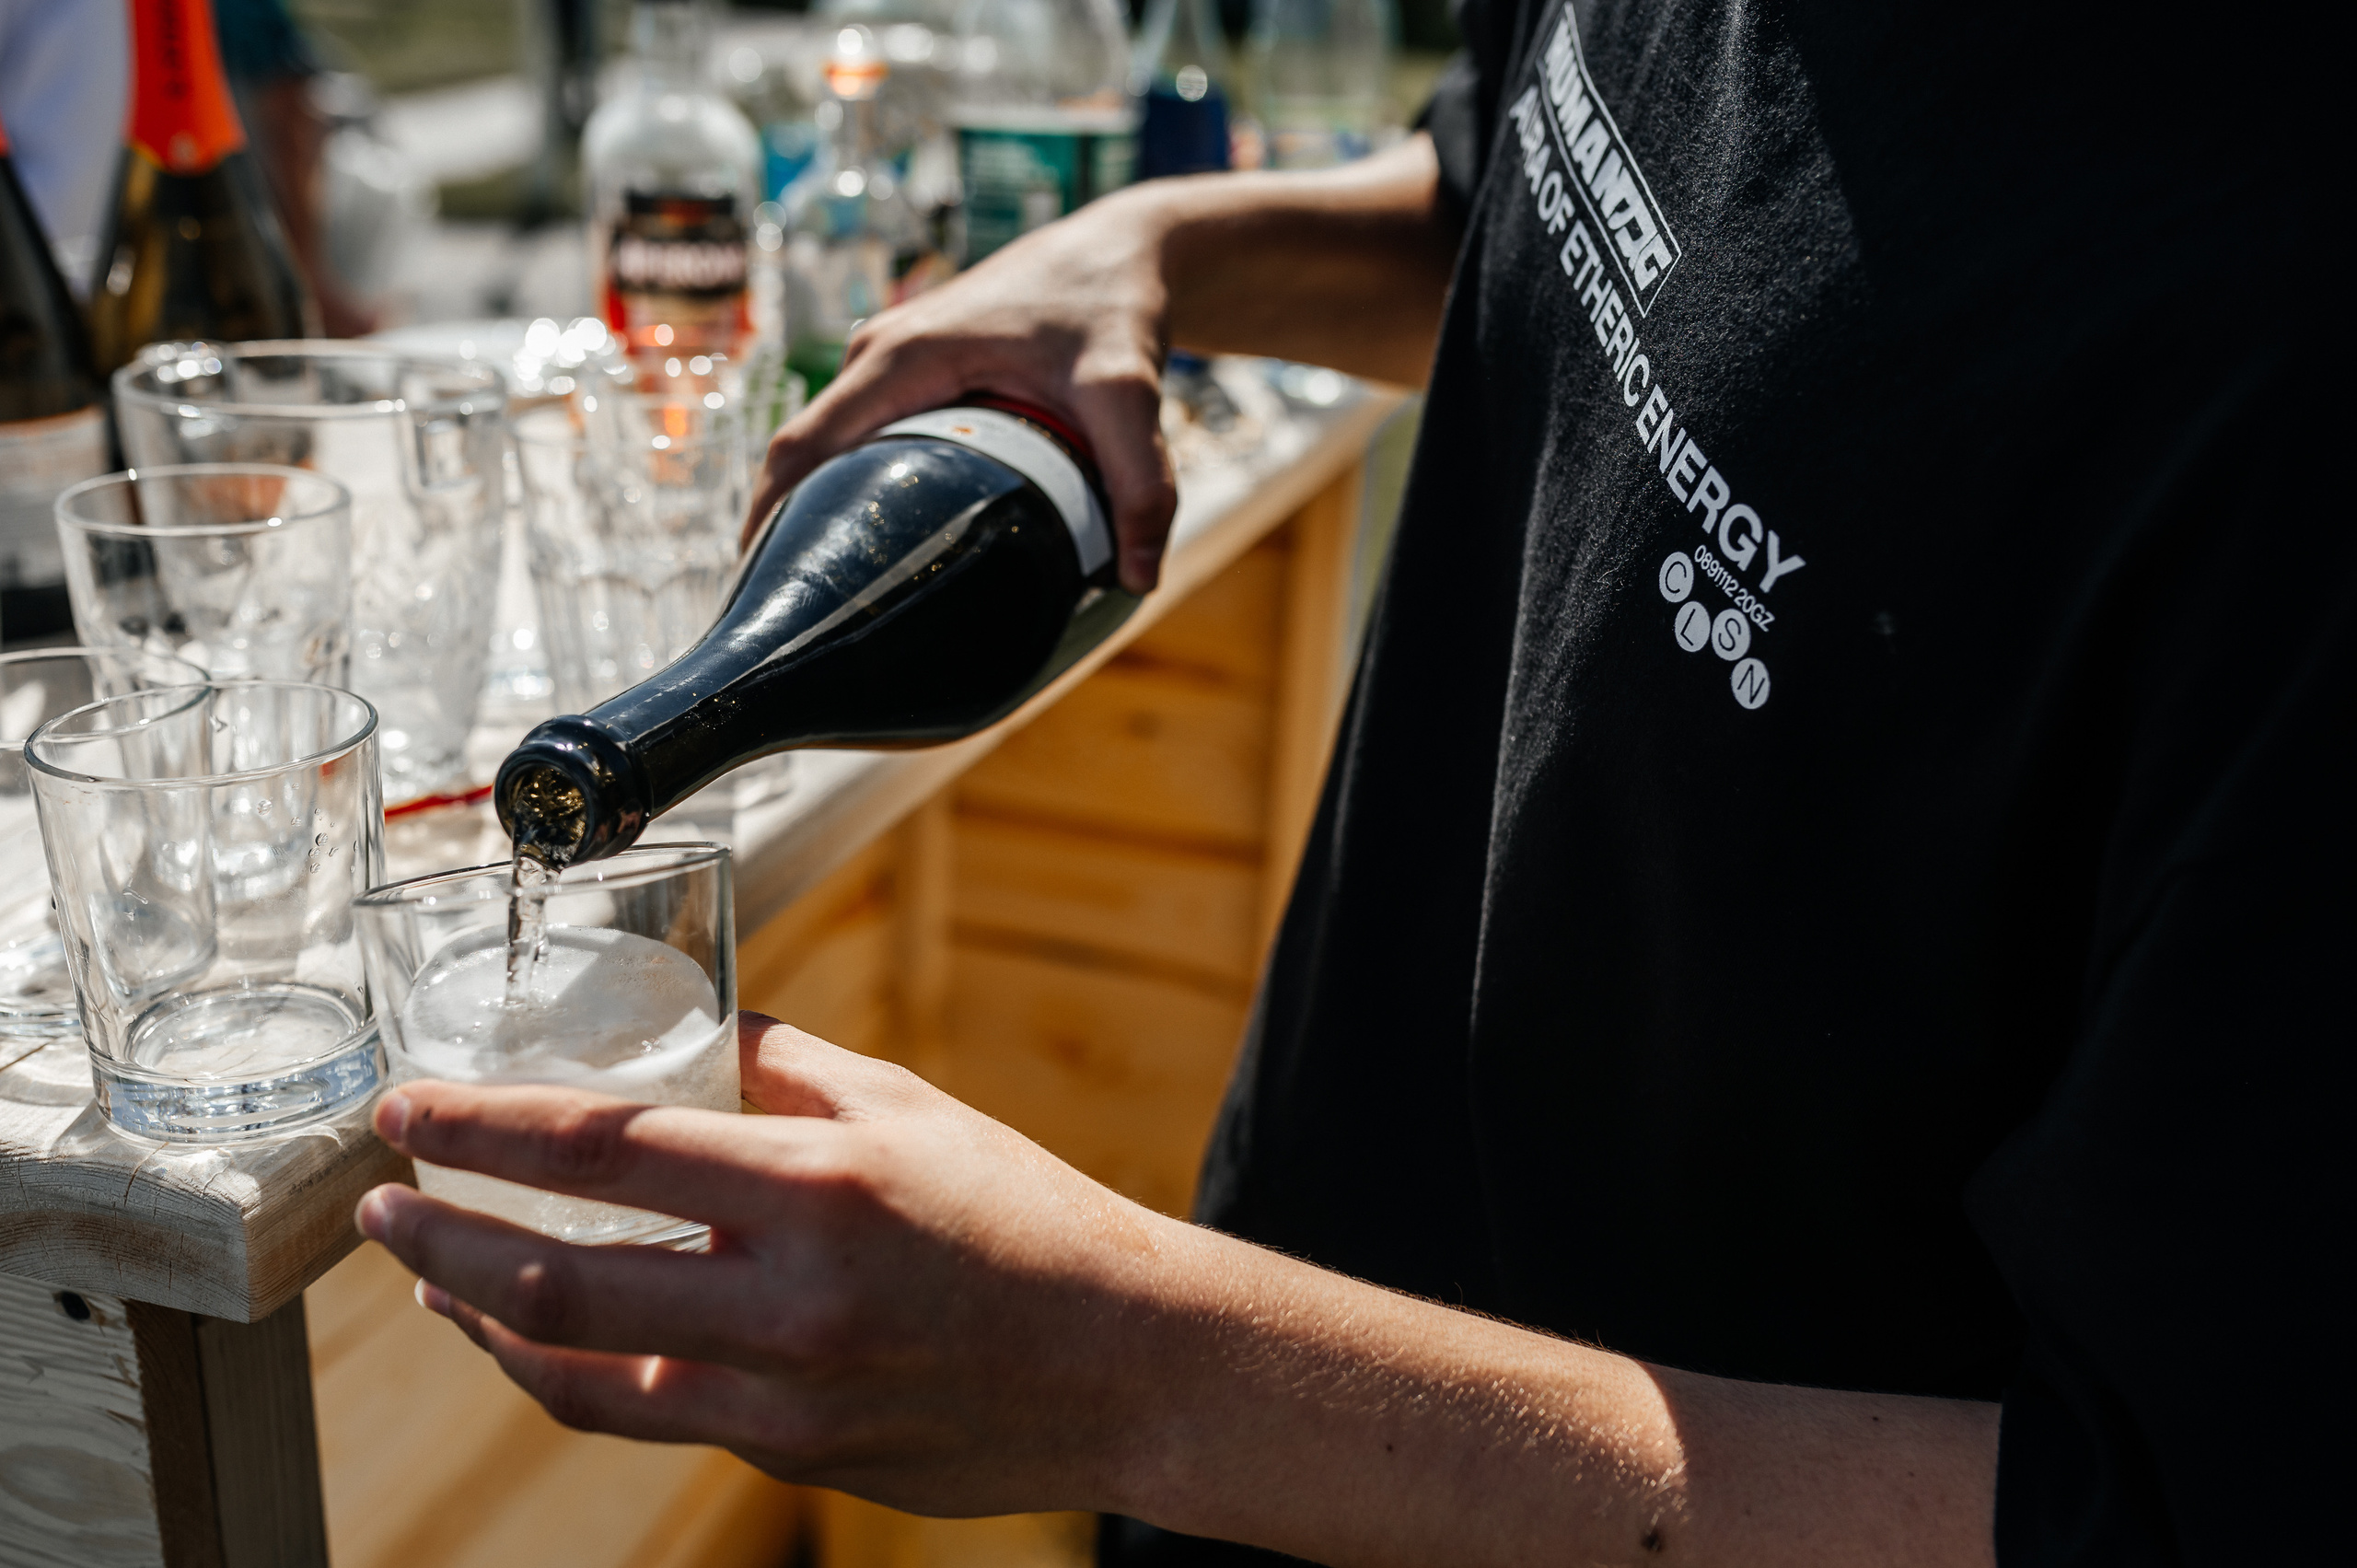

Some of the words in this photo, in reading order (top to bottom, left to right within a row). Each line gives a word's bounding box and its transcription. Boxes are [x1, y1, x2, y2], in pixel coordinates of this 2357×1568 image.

[1538, 169, 1575, 235] OF
[1560, 220, 1650, 407] ETHERIC
[1636, 384, 1806, 594] ENERGY
[1694, 544, 1739, 598] 0891112
